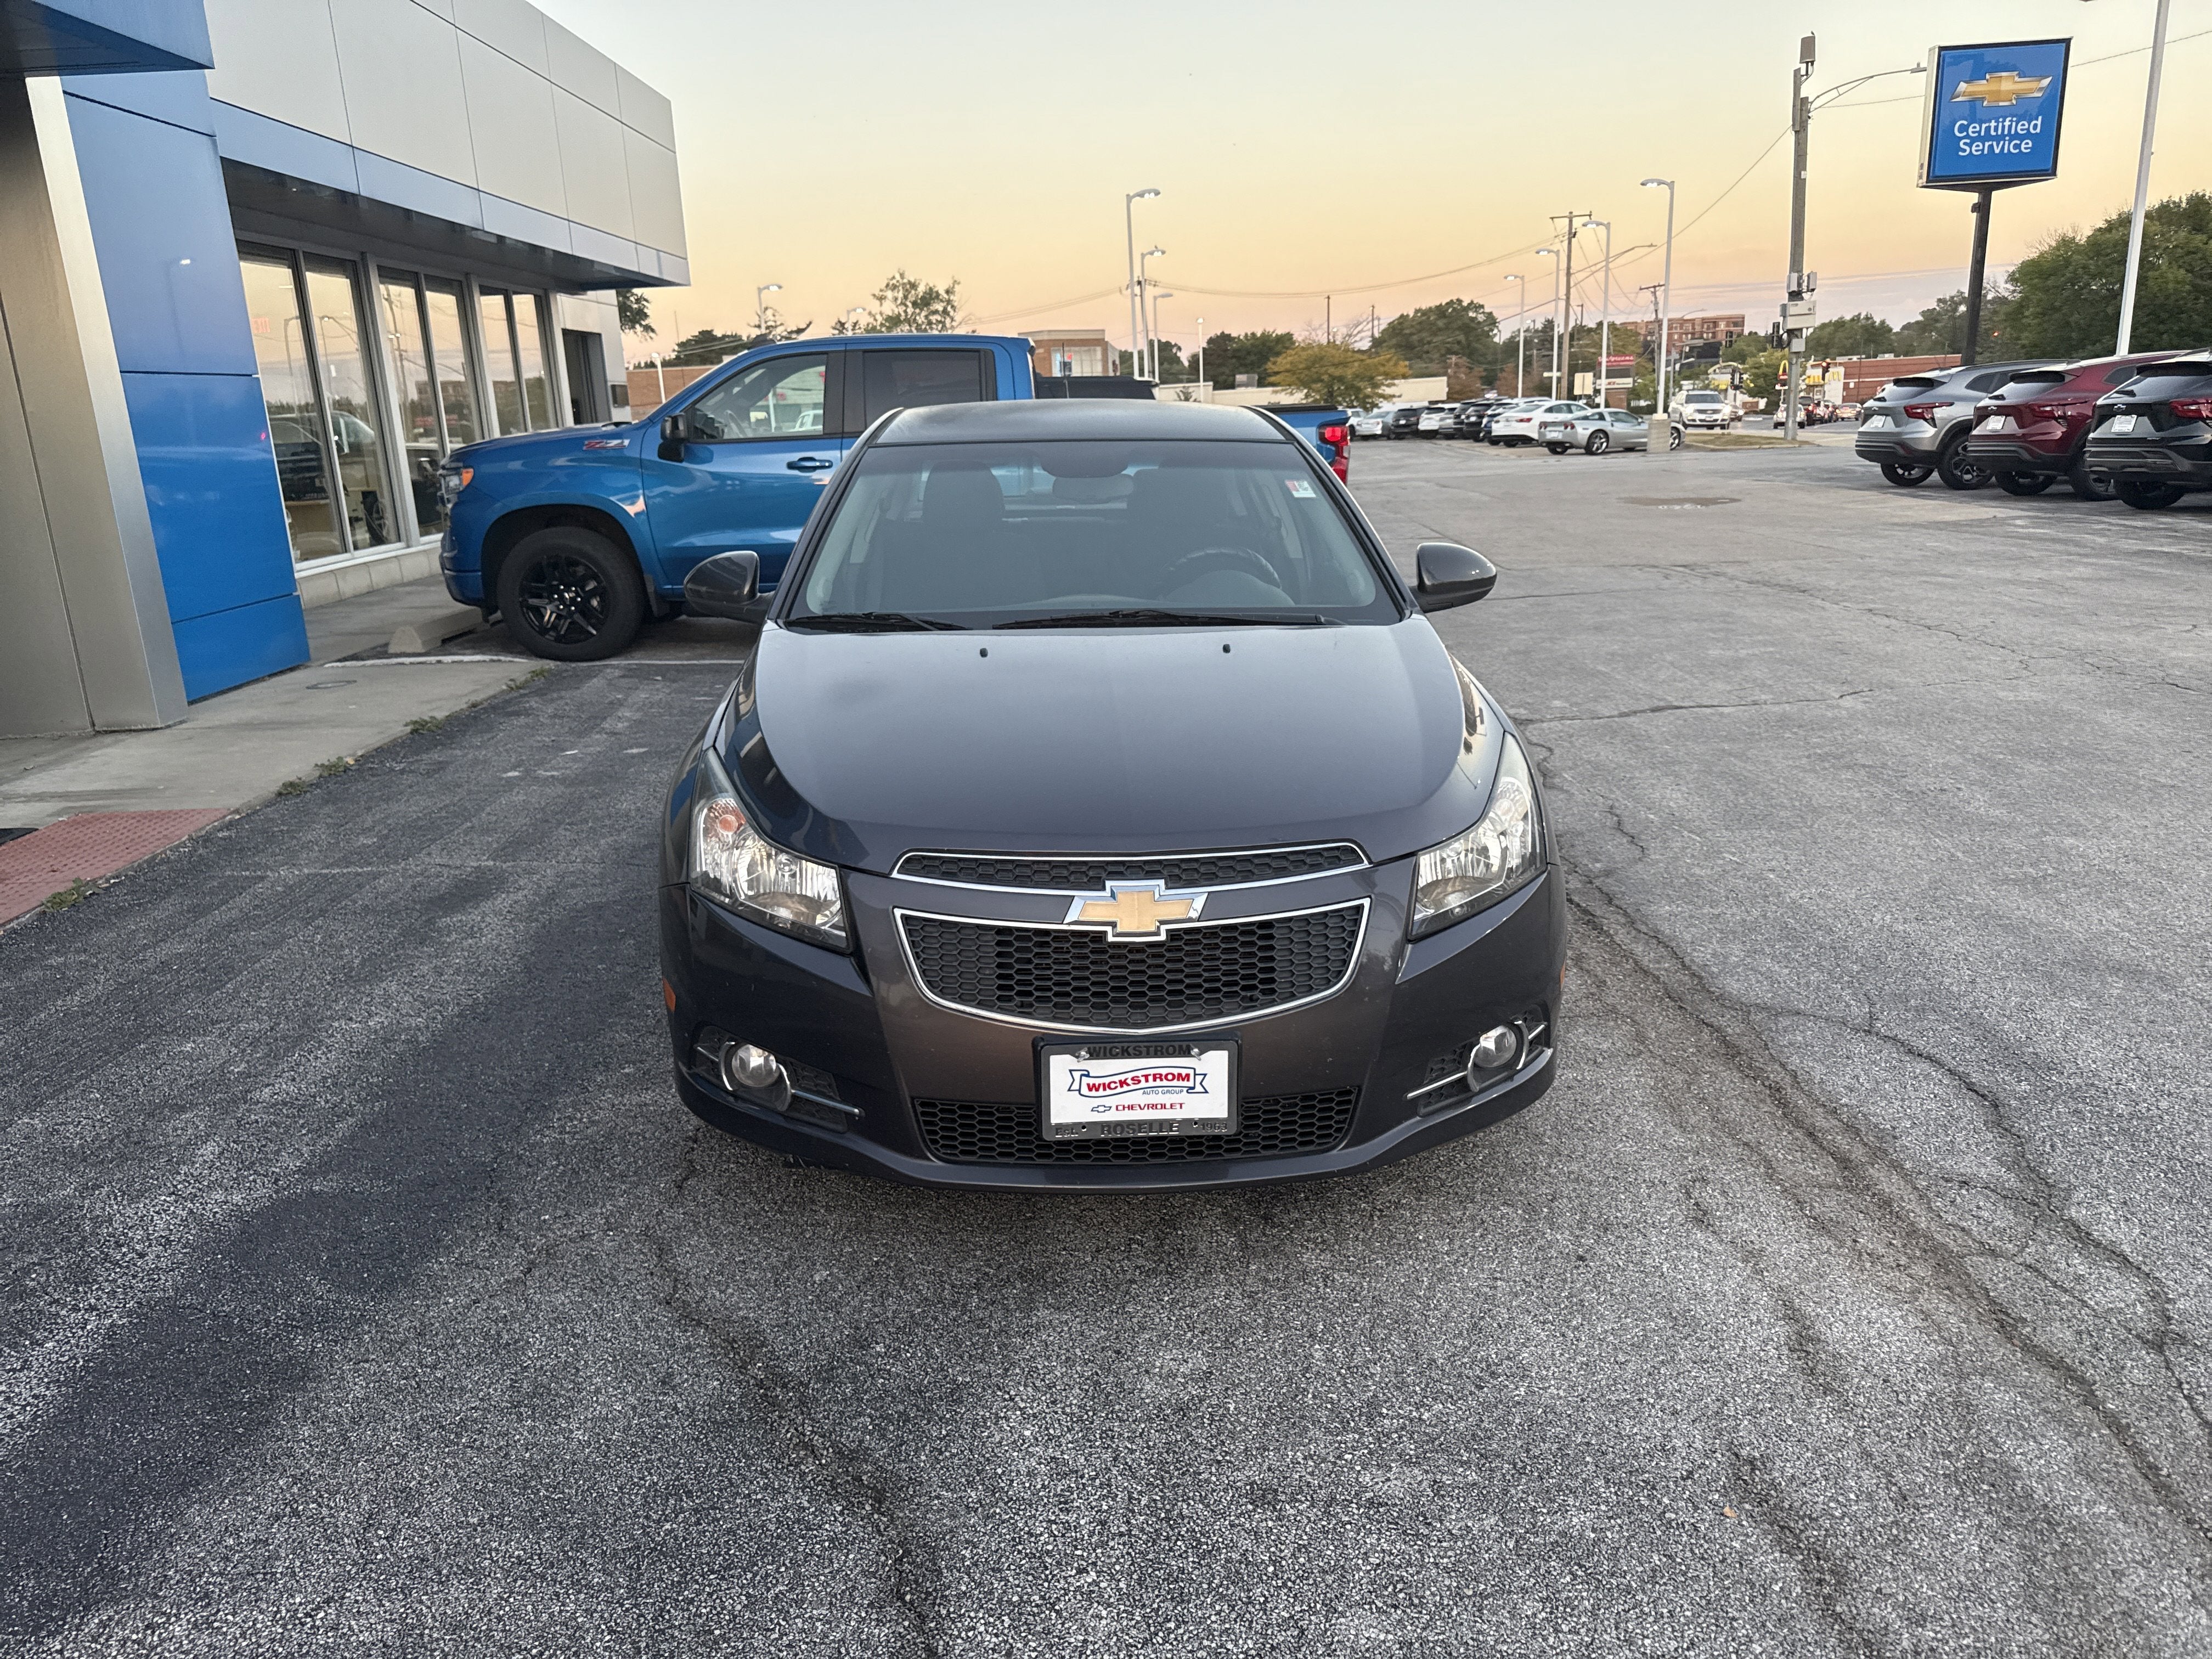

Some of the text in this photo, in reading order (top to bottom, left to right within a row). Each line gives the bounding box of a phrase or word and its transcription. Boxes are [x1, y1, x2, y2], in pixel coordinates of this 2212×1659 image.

[1954, 116, 2042, 137] Certified
[1959, 137, 2032, 156] Service
[1087, 1044, 1191, 1057] WICKSTROM
[1086, 1073, 1190, 1092] WICKSTROM
[1115, 1103, 1185, 1111] CHEVROLET
[1101, 1121, 1180, 1137] ROSELLE
[1200, 1122, 1228, 1132] 1963
